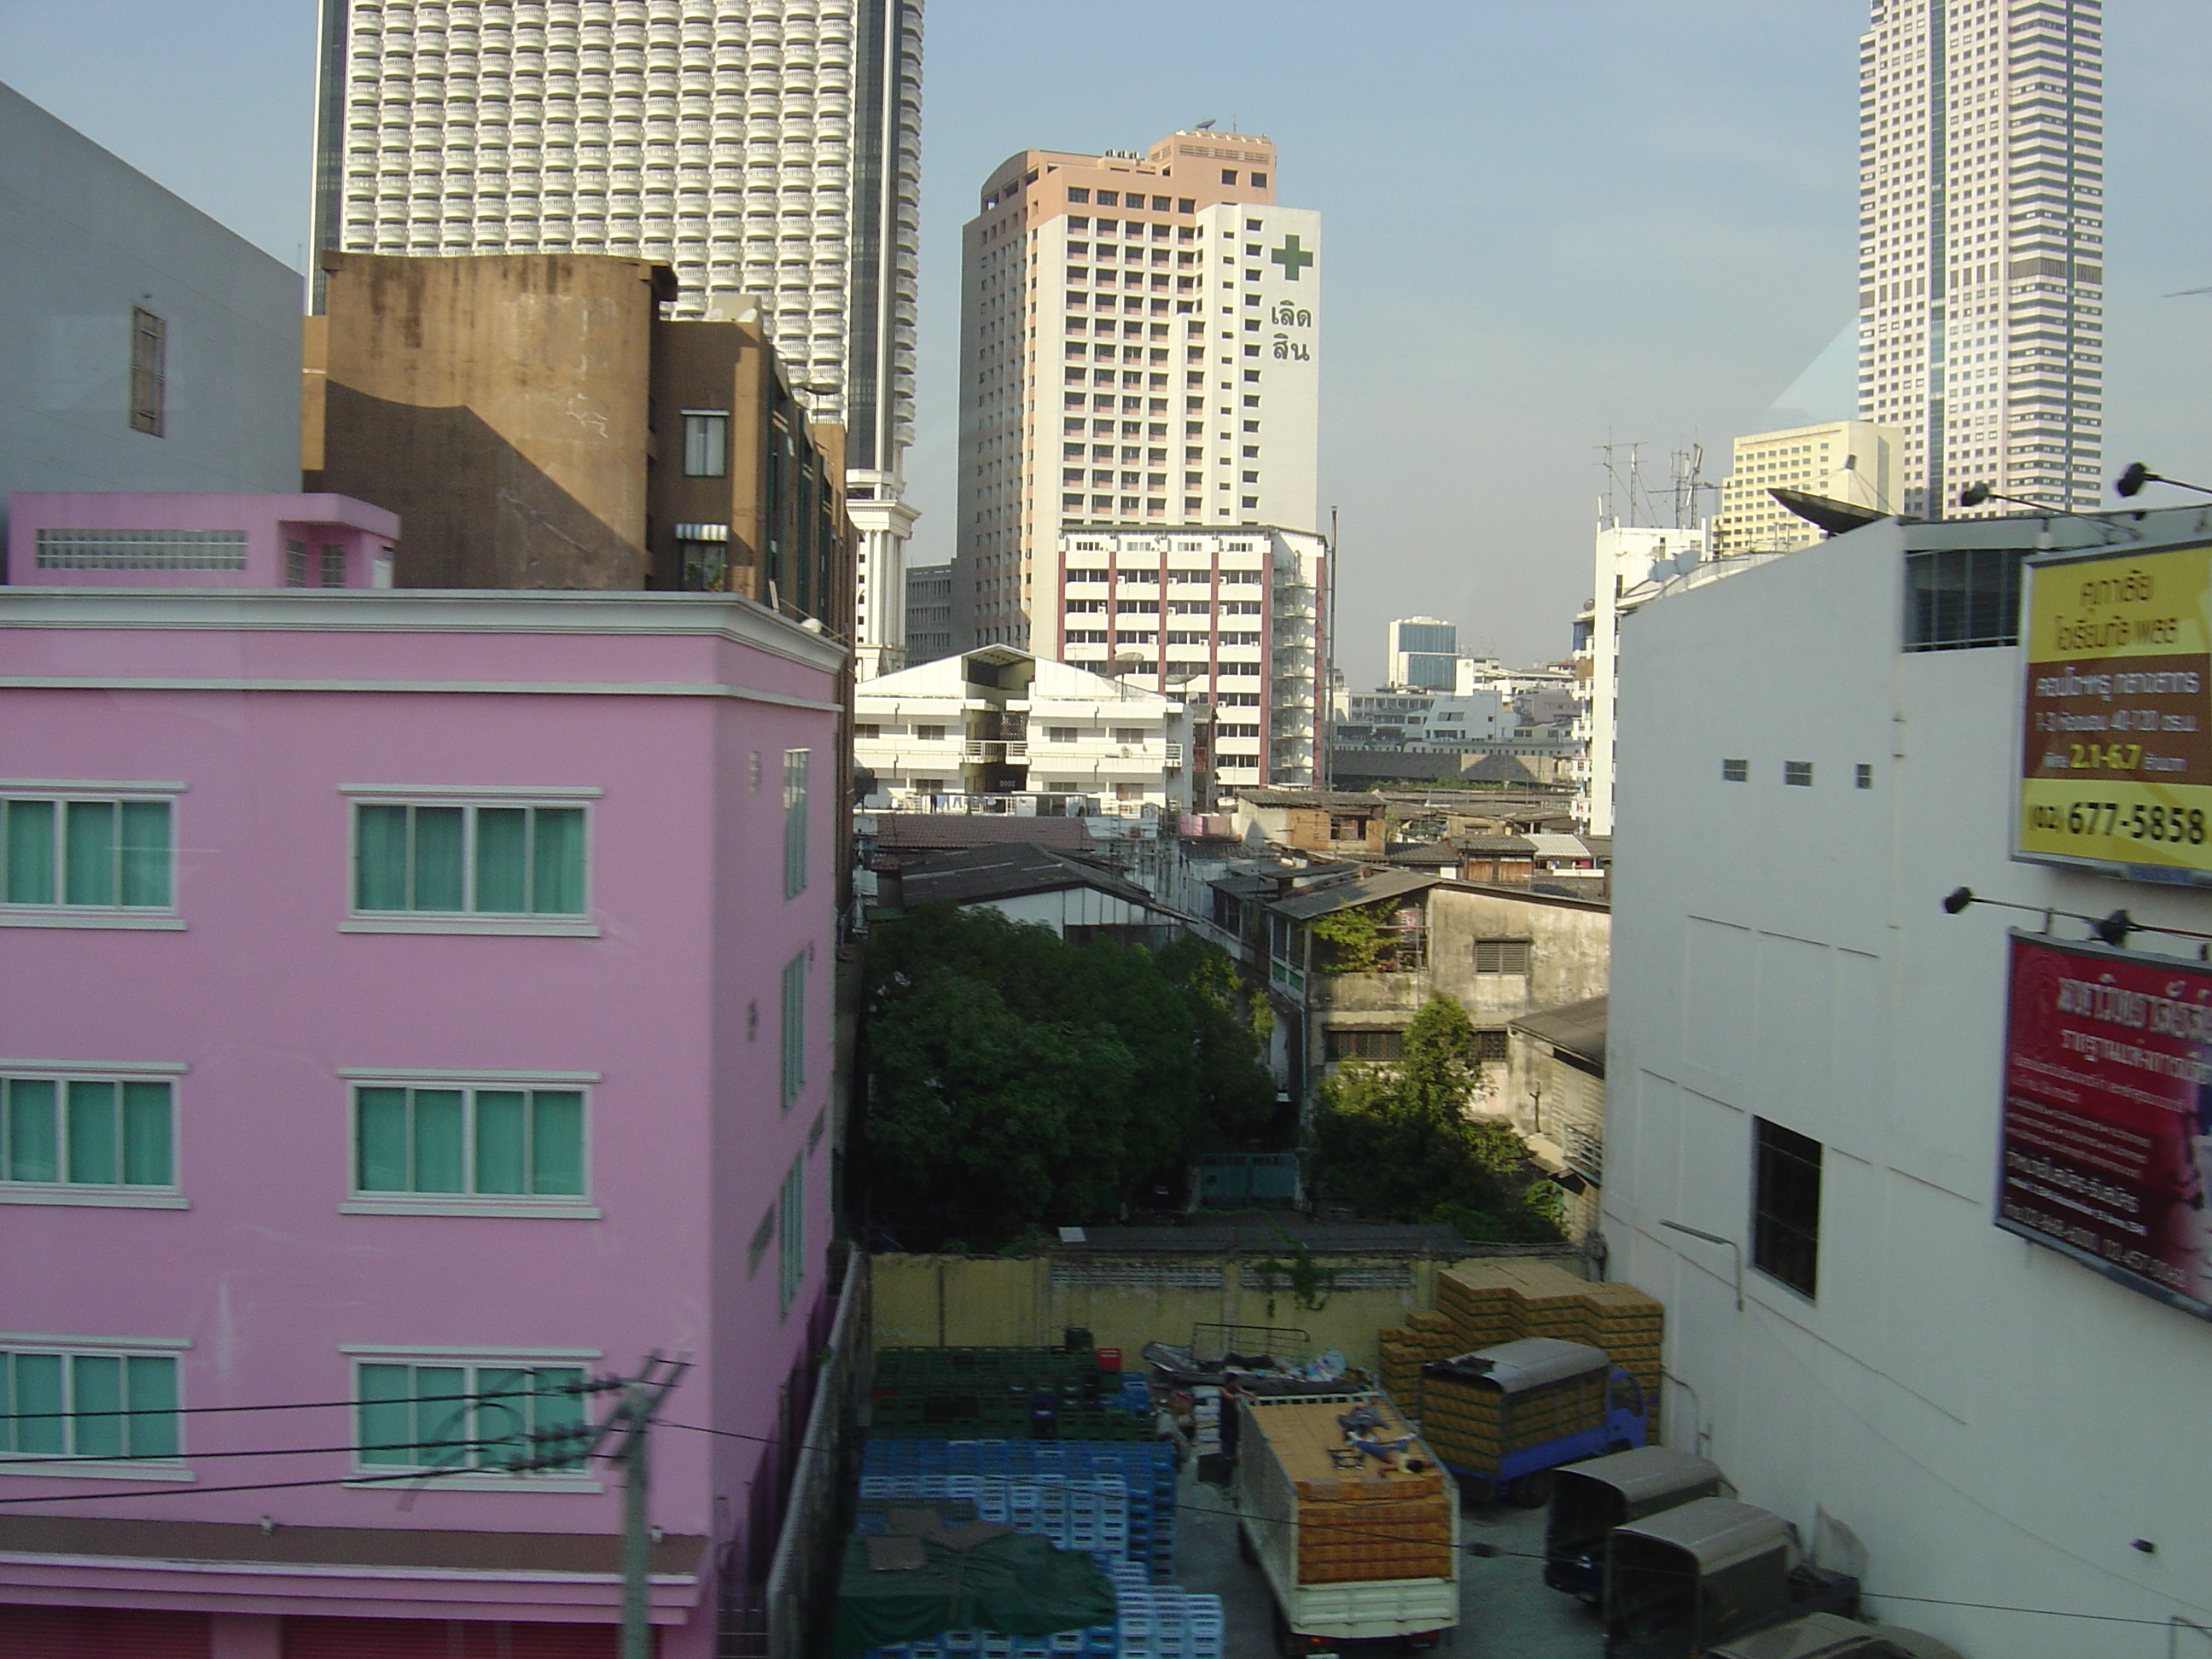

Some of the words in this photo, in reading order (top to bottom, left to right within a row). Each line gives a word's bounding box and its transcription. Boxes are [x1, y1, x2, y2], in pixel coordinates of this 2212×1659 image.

[1271, 300, 1312, 328] เลิด
[1272, 333, 1310, 362] สิน
[2069, 802, 2205, 844] 677-5858
